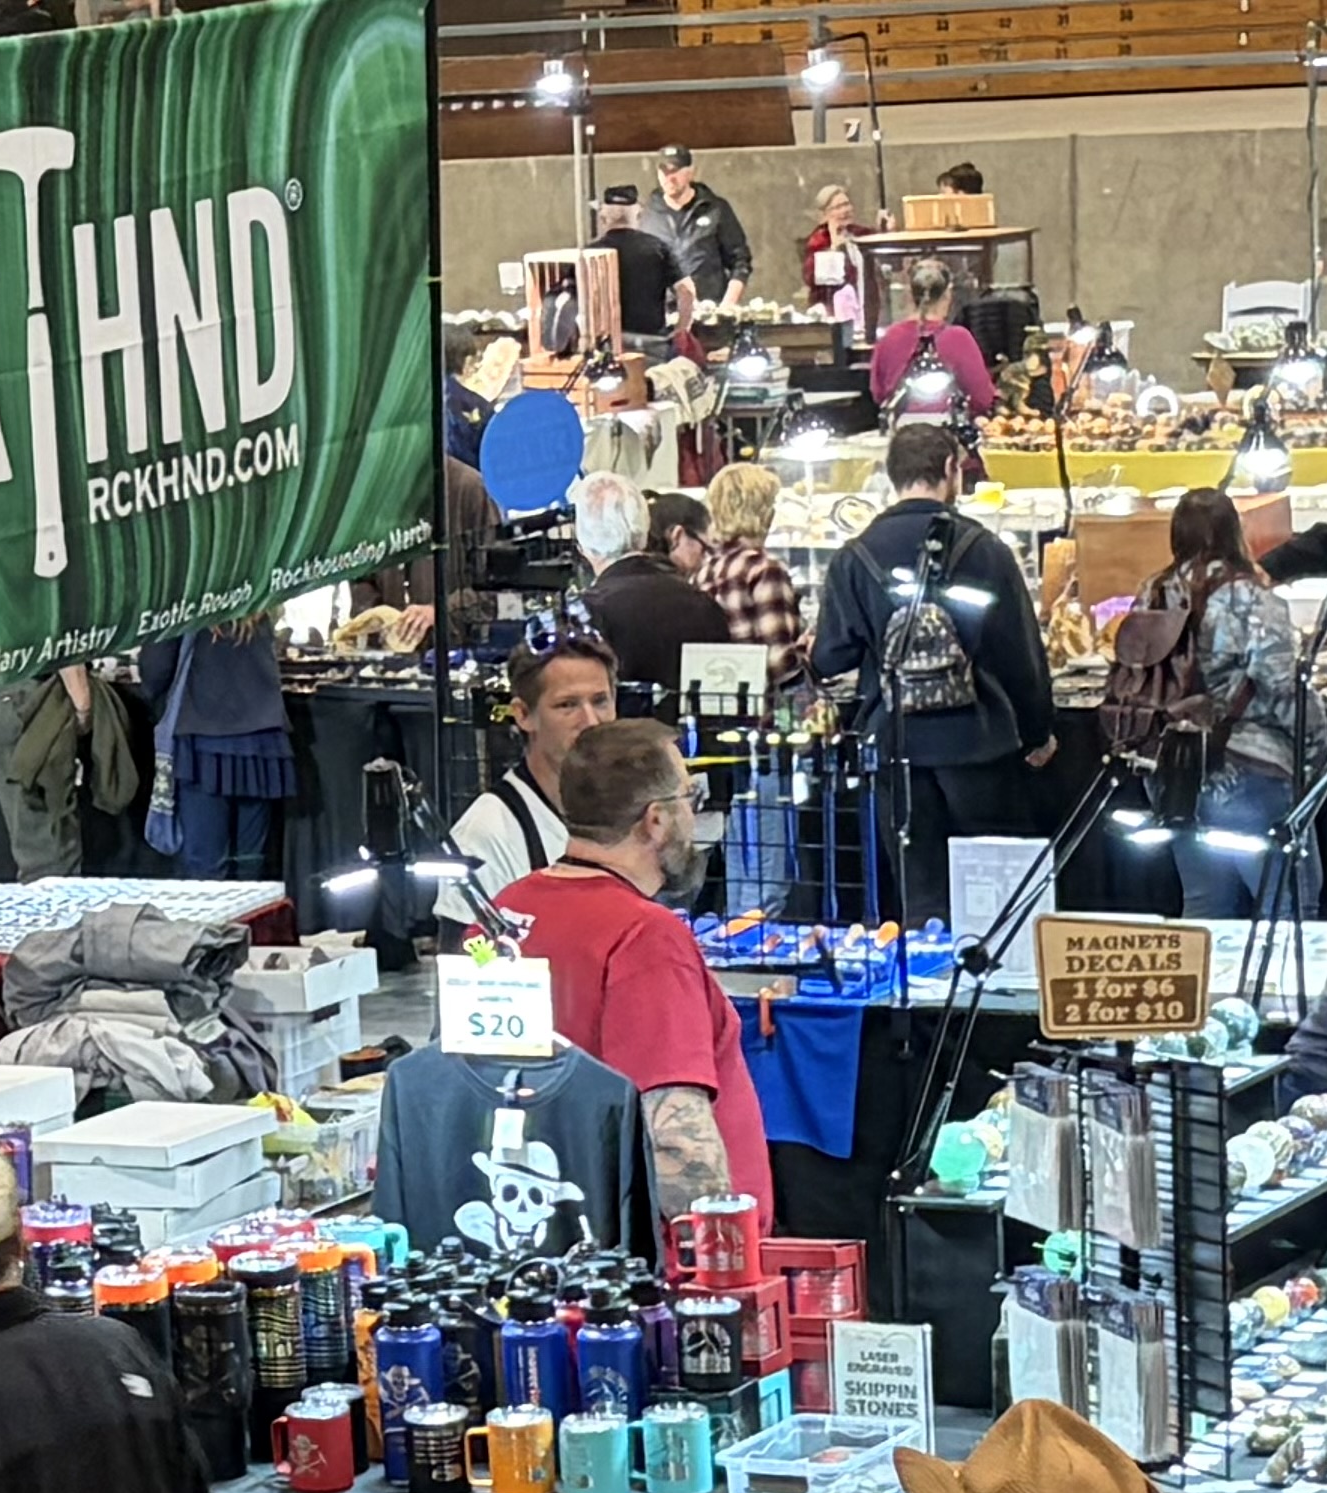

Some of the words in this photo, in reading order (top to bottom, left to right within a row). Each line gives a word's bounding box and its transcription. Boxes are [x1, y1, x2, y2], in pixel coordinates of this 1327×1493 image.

[87, 423, 300, 525] RCKHND.COM
[39, 623, 118, 664] Artistry
[136, 603, 194, 637] Exotic
[197, 581, 253, 617] Rough
[269, 538, 387, 593] Rockhounding
[388, 517, 433, 554] Merch
[1066, 934, 1181, 951] MAGNETS
[1065, 953, 1182, 974] DECALS
[1073, 980, 1088, 999] 1
[1094, 976, 1138, 999] for
[1142, 978, 1175, 998] $6
[1065, 1003, 1081, 1023] 2
[1087, 1001, 1131, 1022] for
[1135, 1001, 1184, 1022] $10
[468, 1012, 524, 1038] $20
[847, 1362, 914, 1377] ENGRAVED
[844, 1380, 918, 1399] SKIPPIN
[844, 1399, 919, 1418] STONES
